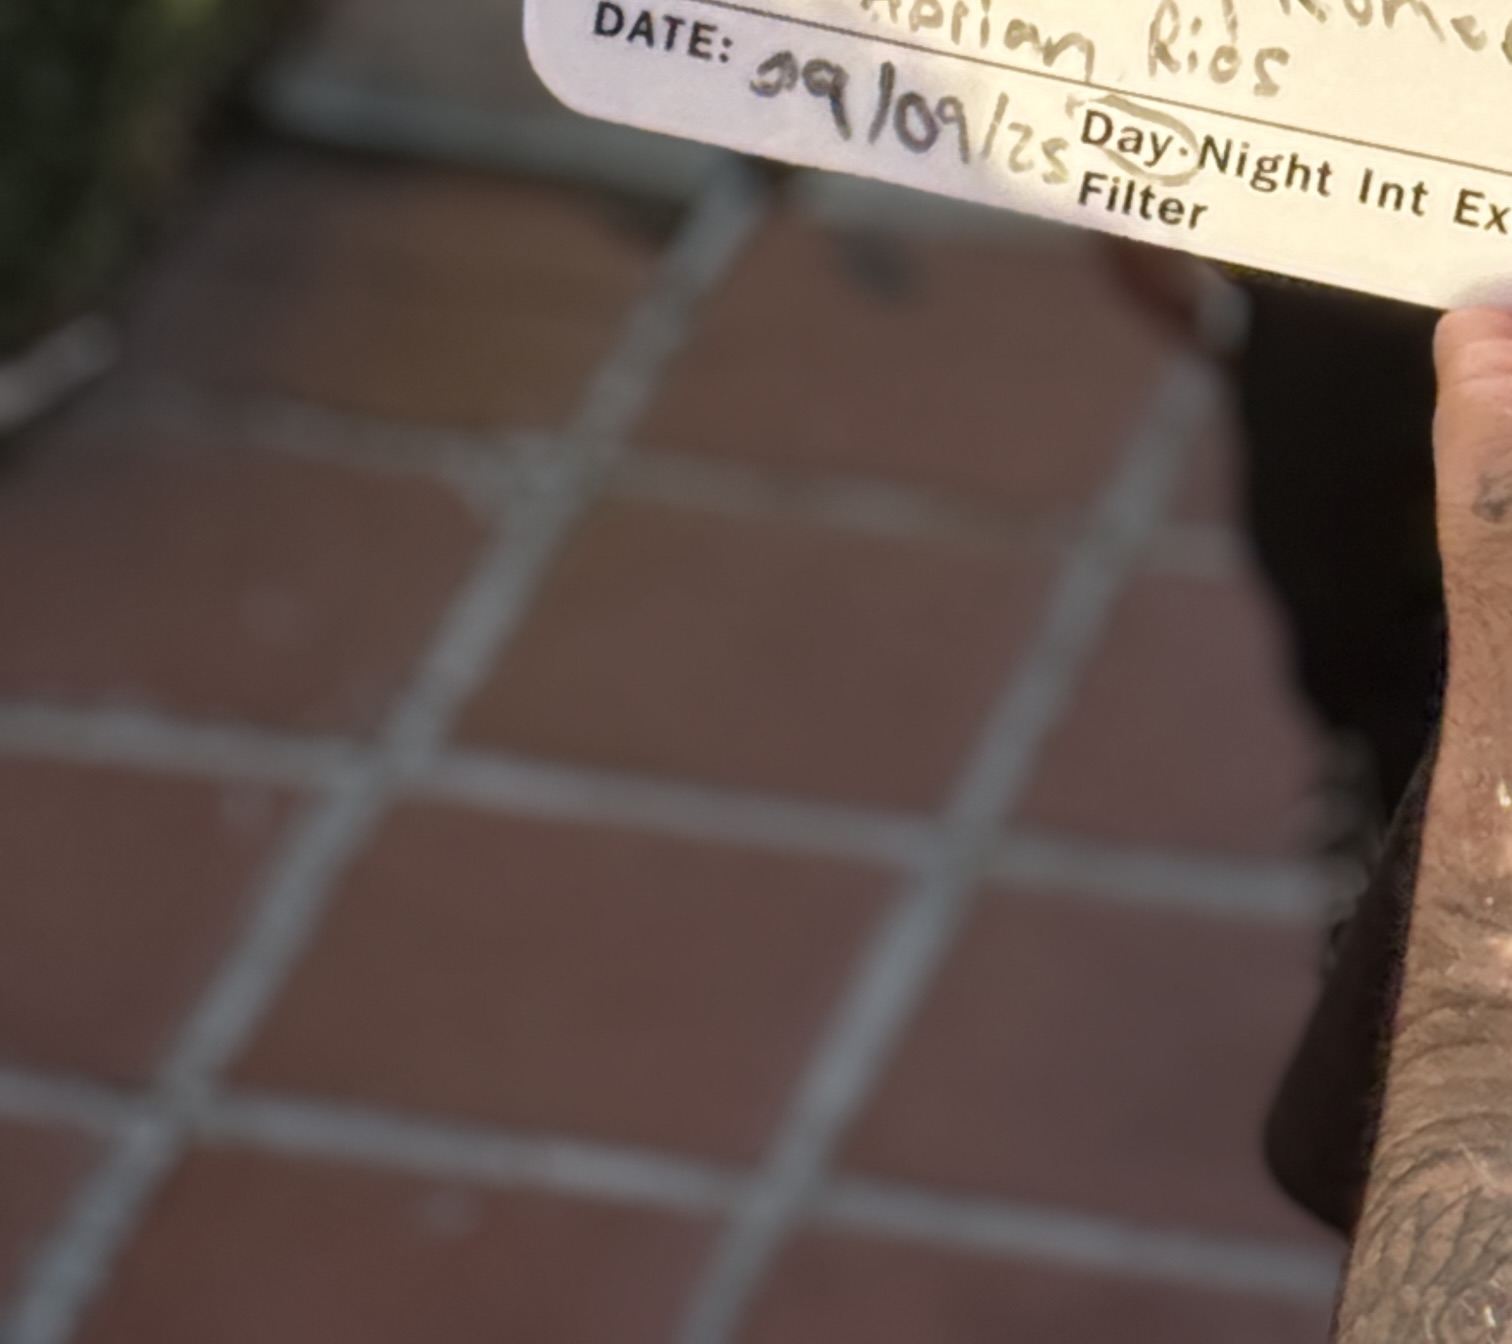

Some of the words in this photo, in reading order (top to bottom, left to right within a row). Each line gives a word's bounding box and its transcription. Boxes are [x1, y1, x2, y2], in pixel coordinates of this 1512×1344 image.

[592, 0, 734, 64] DATE:
[1078, 171, 1208, 230] Filter
[1198, 133, 1334, 196] Night
[1358, 168, 1428, 216] Int
